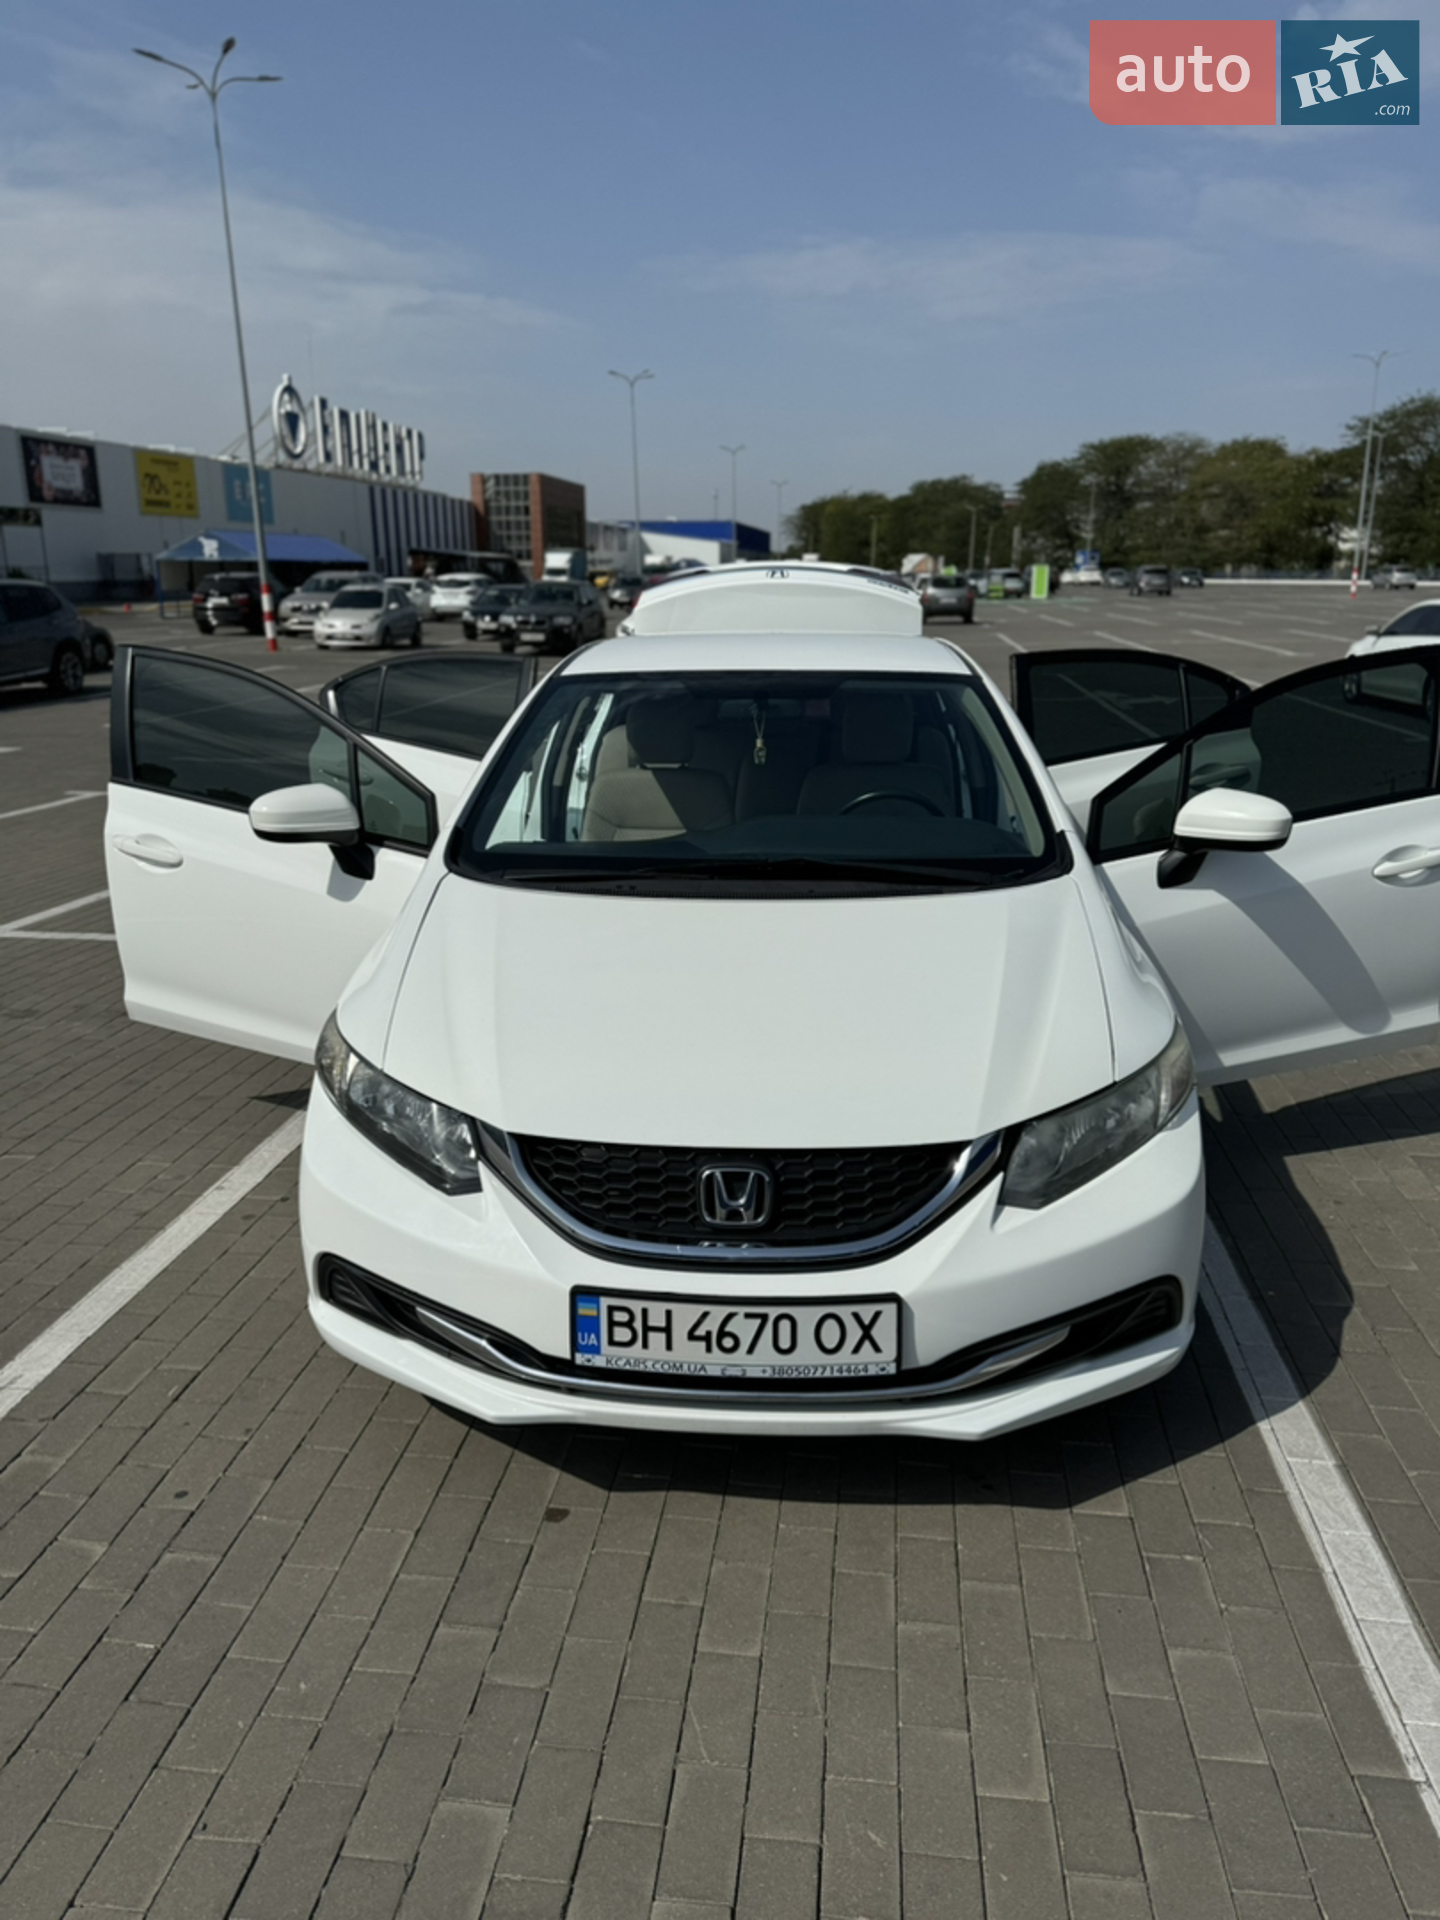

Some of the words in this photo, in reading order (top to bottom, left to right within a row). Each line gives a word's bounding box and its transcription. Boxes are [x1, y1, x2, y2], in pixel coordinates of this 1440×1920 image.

[577, 1331, 598, 1346] UA
[606, 1304, 673, 1352] BH
[687, 1310, 798, 1355] 4670
[813, 1310, 884, 1355] OX
[606, 1355, 708, 1374] KCARS.COM.UA
